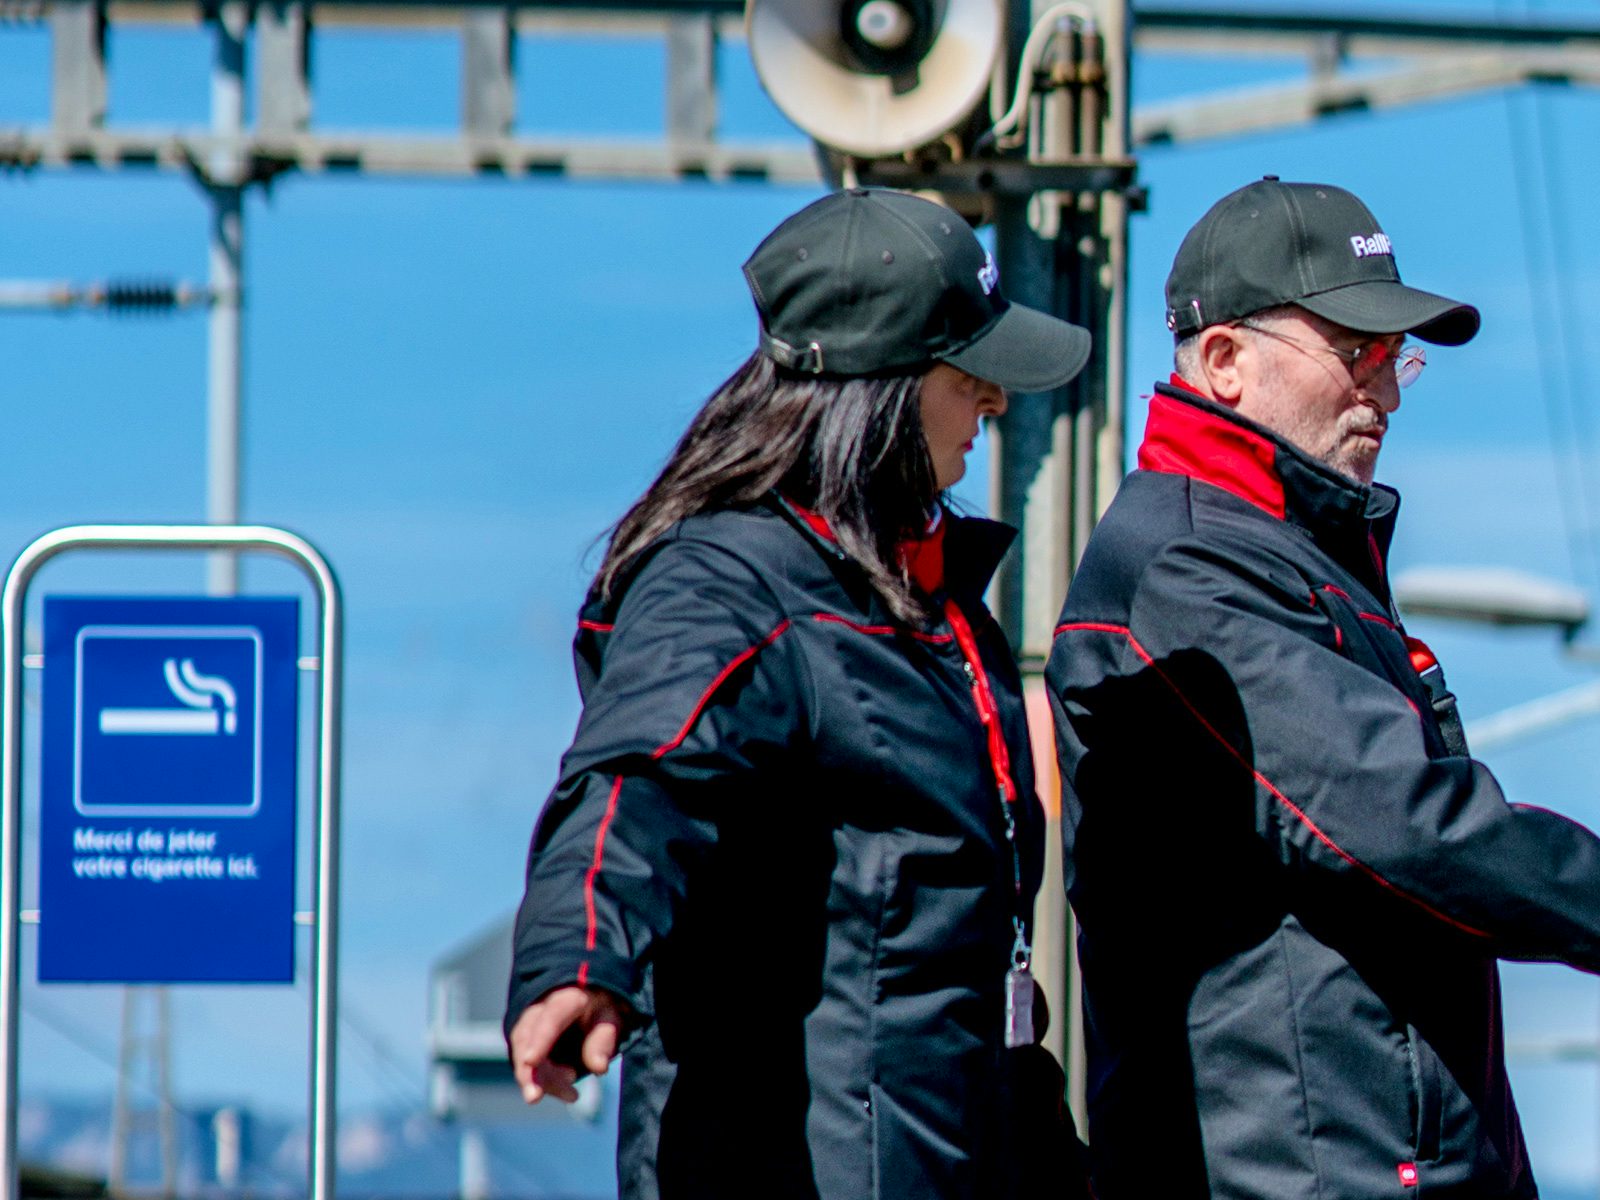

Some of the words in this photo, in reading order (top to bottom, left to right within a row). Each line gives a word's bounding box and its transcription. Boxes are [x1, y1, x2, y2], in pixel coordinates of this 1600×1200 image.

[74, 828, 133, 851] Merci
[137, 828, 164, 851] de
[168, 828, 217, 854] jeter
[73, 855, 127, 878] votre
[131, 855, 224, 882] cigarette
